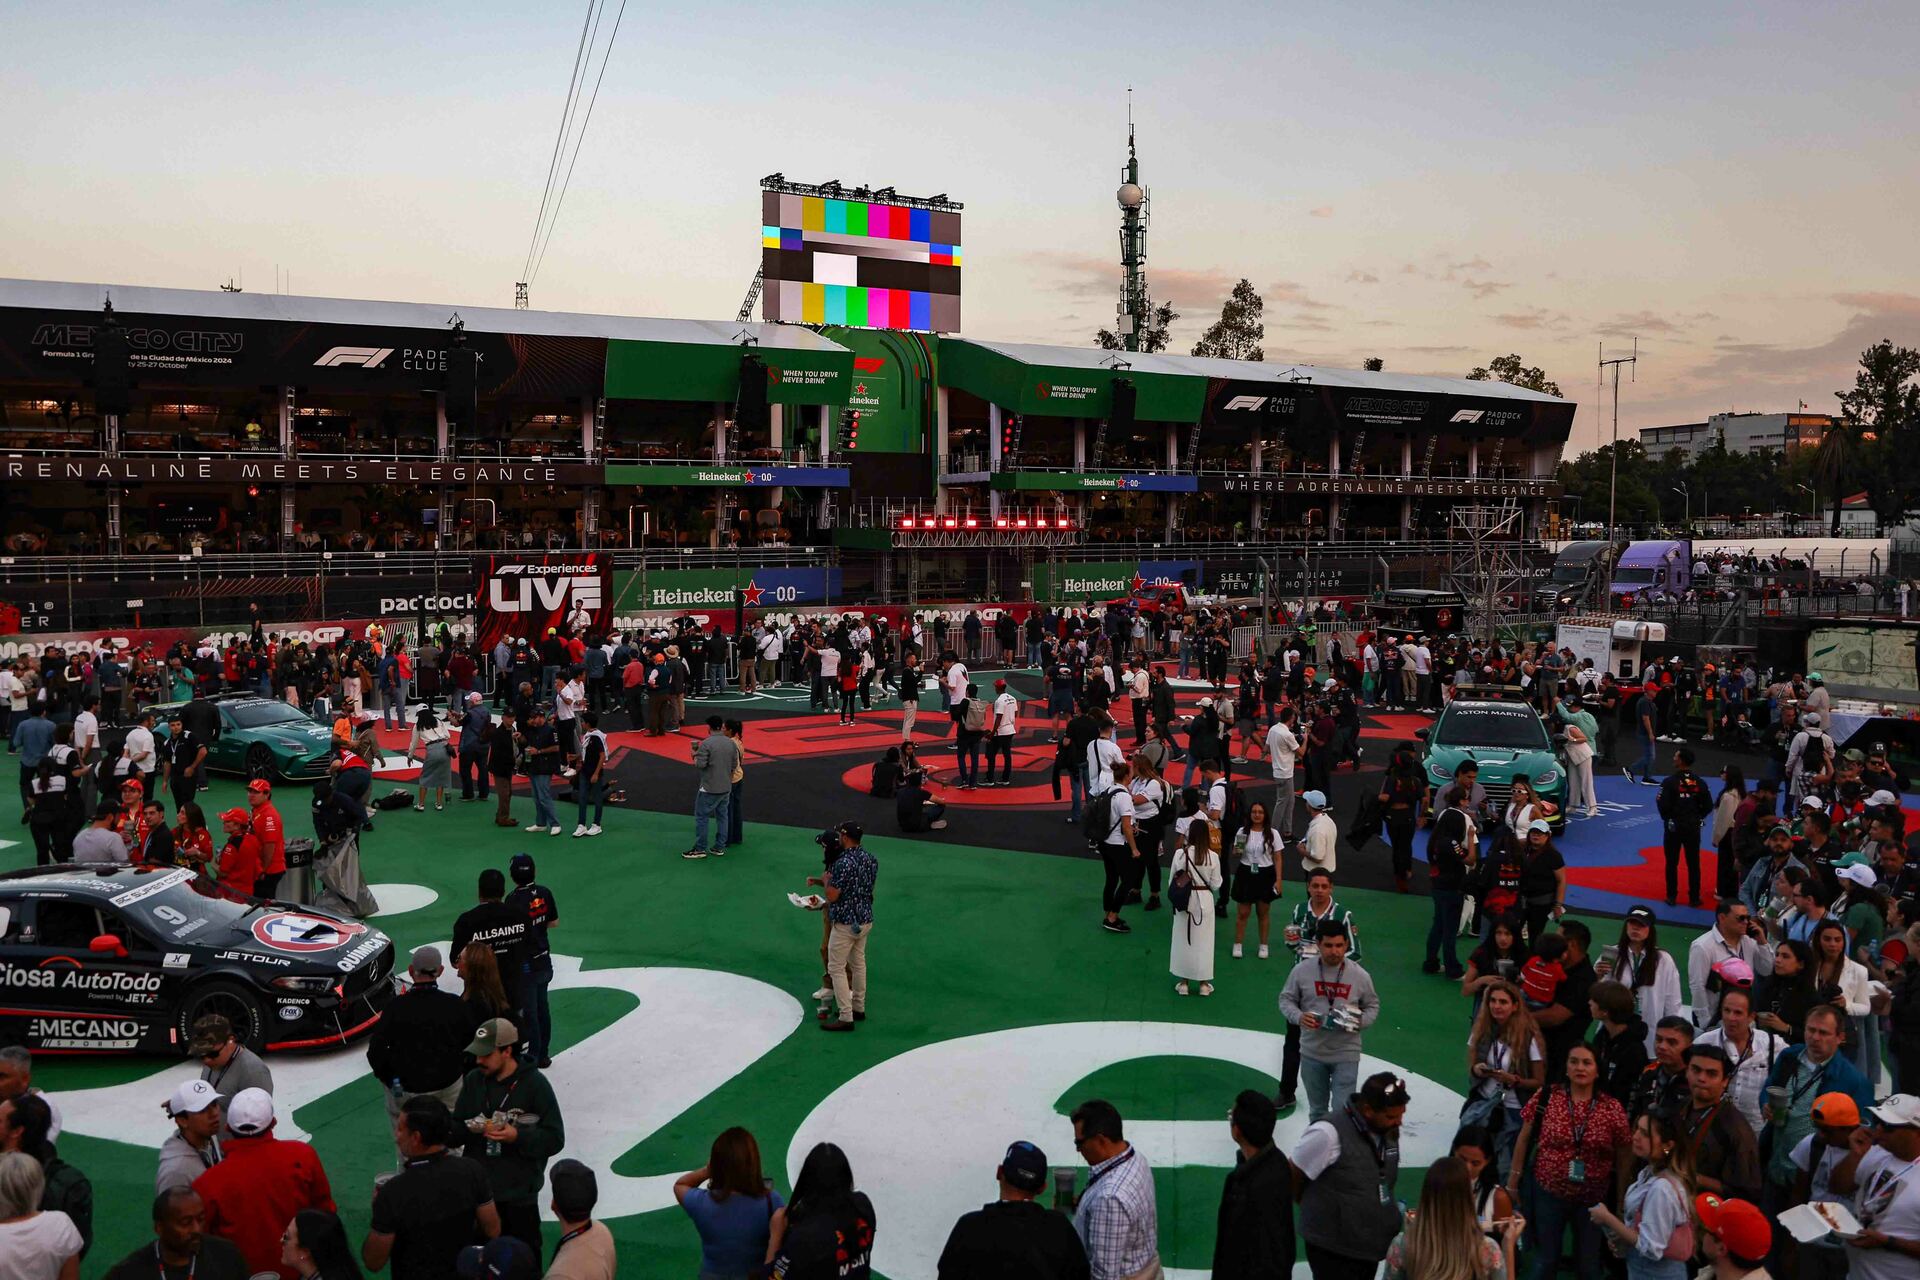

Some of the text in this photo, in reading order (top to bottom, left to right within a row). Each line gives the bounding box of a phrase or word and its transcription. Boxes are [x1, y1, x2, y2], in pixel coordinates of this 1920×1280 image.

[172, 330, 244, 353] CITY
[43, 350, 75, 358] Formula
[130, 353, 140, 361] de
[140, 353, 148, 361] la
[149, 354, 174, 362] Ciudad
[136, 361, 158, 369] 25-27
[158, 362, 188, 370] October
[804, 370, 819, 378] YOU
[782, 376, 804, 384] NEVER
[1051, 385, 1069, 393] WHEN
[849, 395, 880, 405] eineken
[1344, 396, 1430, 415] MEXICO CITY
[1487, 410, 1522, 420] PADDOCK
[1486, 418, 1506, 426] CLUB
[241, 463, 358, 480] MEETS
[386, 465, 556, 481] ELEGANCE
[698, 471, 741, 481] Heineken
[1083, 478, 1115, 487] Heineken
[1224, 480, 1545, 496] WHERE ADRENALINE MEETS ELEGANCE
[527, 563, 598, 575] Experiences
[1219, 571, 1242, 580] SEE
[1064, 577, 1125, 592] Heineken
[1220, 581, 1250, 591] VIEW
[489, 575, 602, 612] LIVE
[652, 587, 736, 605] Heineken
[1490, 710, 1528, 719] MARTIN
[152, 905, 188, 925] 9
[471, 923, 525, 942] ALLSAINTS
[214, 951, 291, 967] JETOUR
[336, 937, 387, 973] QUÍMICA
[61, 970, 161, 992] AutoTodo
[88, 992, 115, 1000] Powered
[115, 993, 124, 1002] by
[276, 997, 310, 1005] KADENCO
[283, 1008, 299, 1016] FOX
[40, 1019, 140, 1037] MECANO
